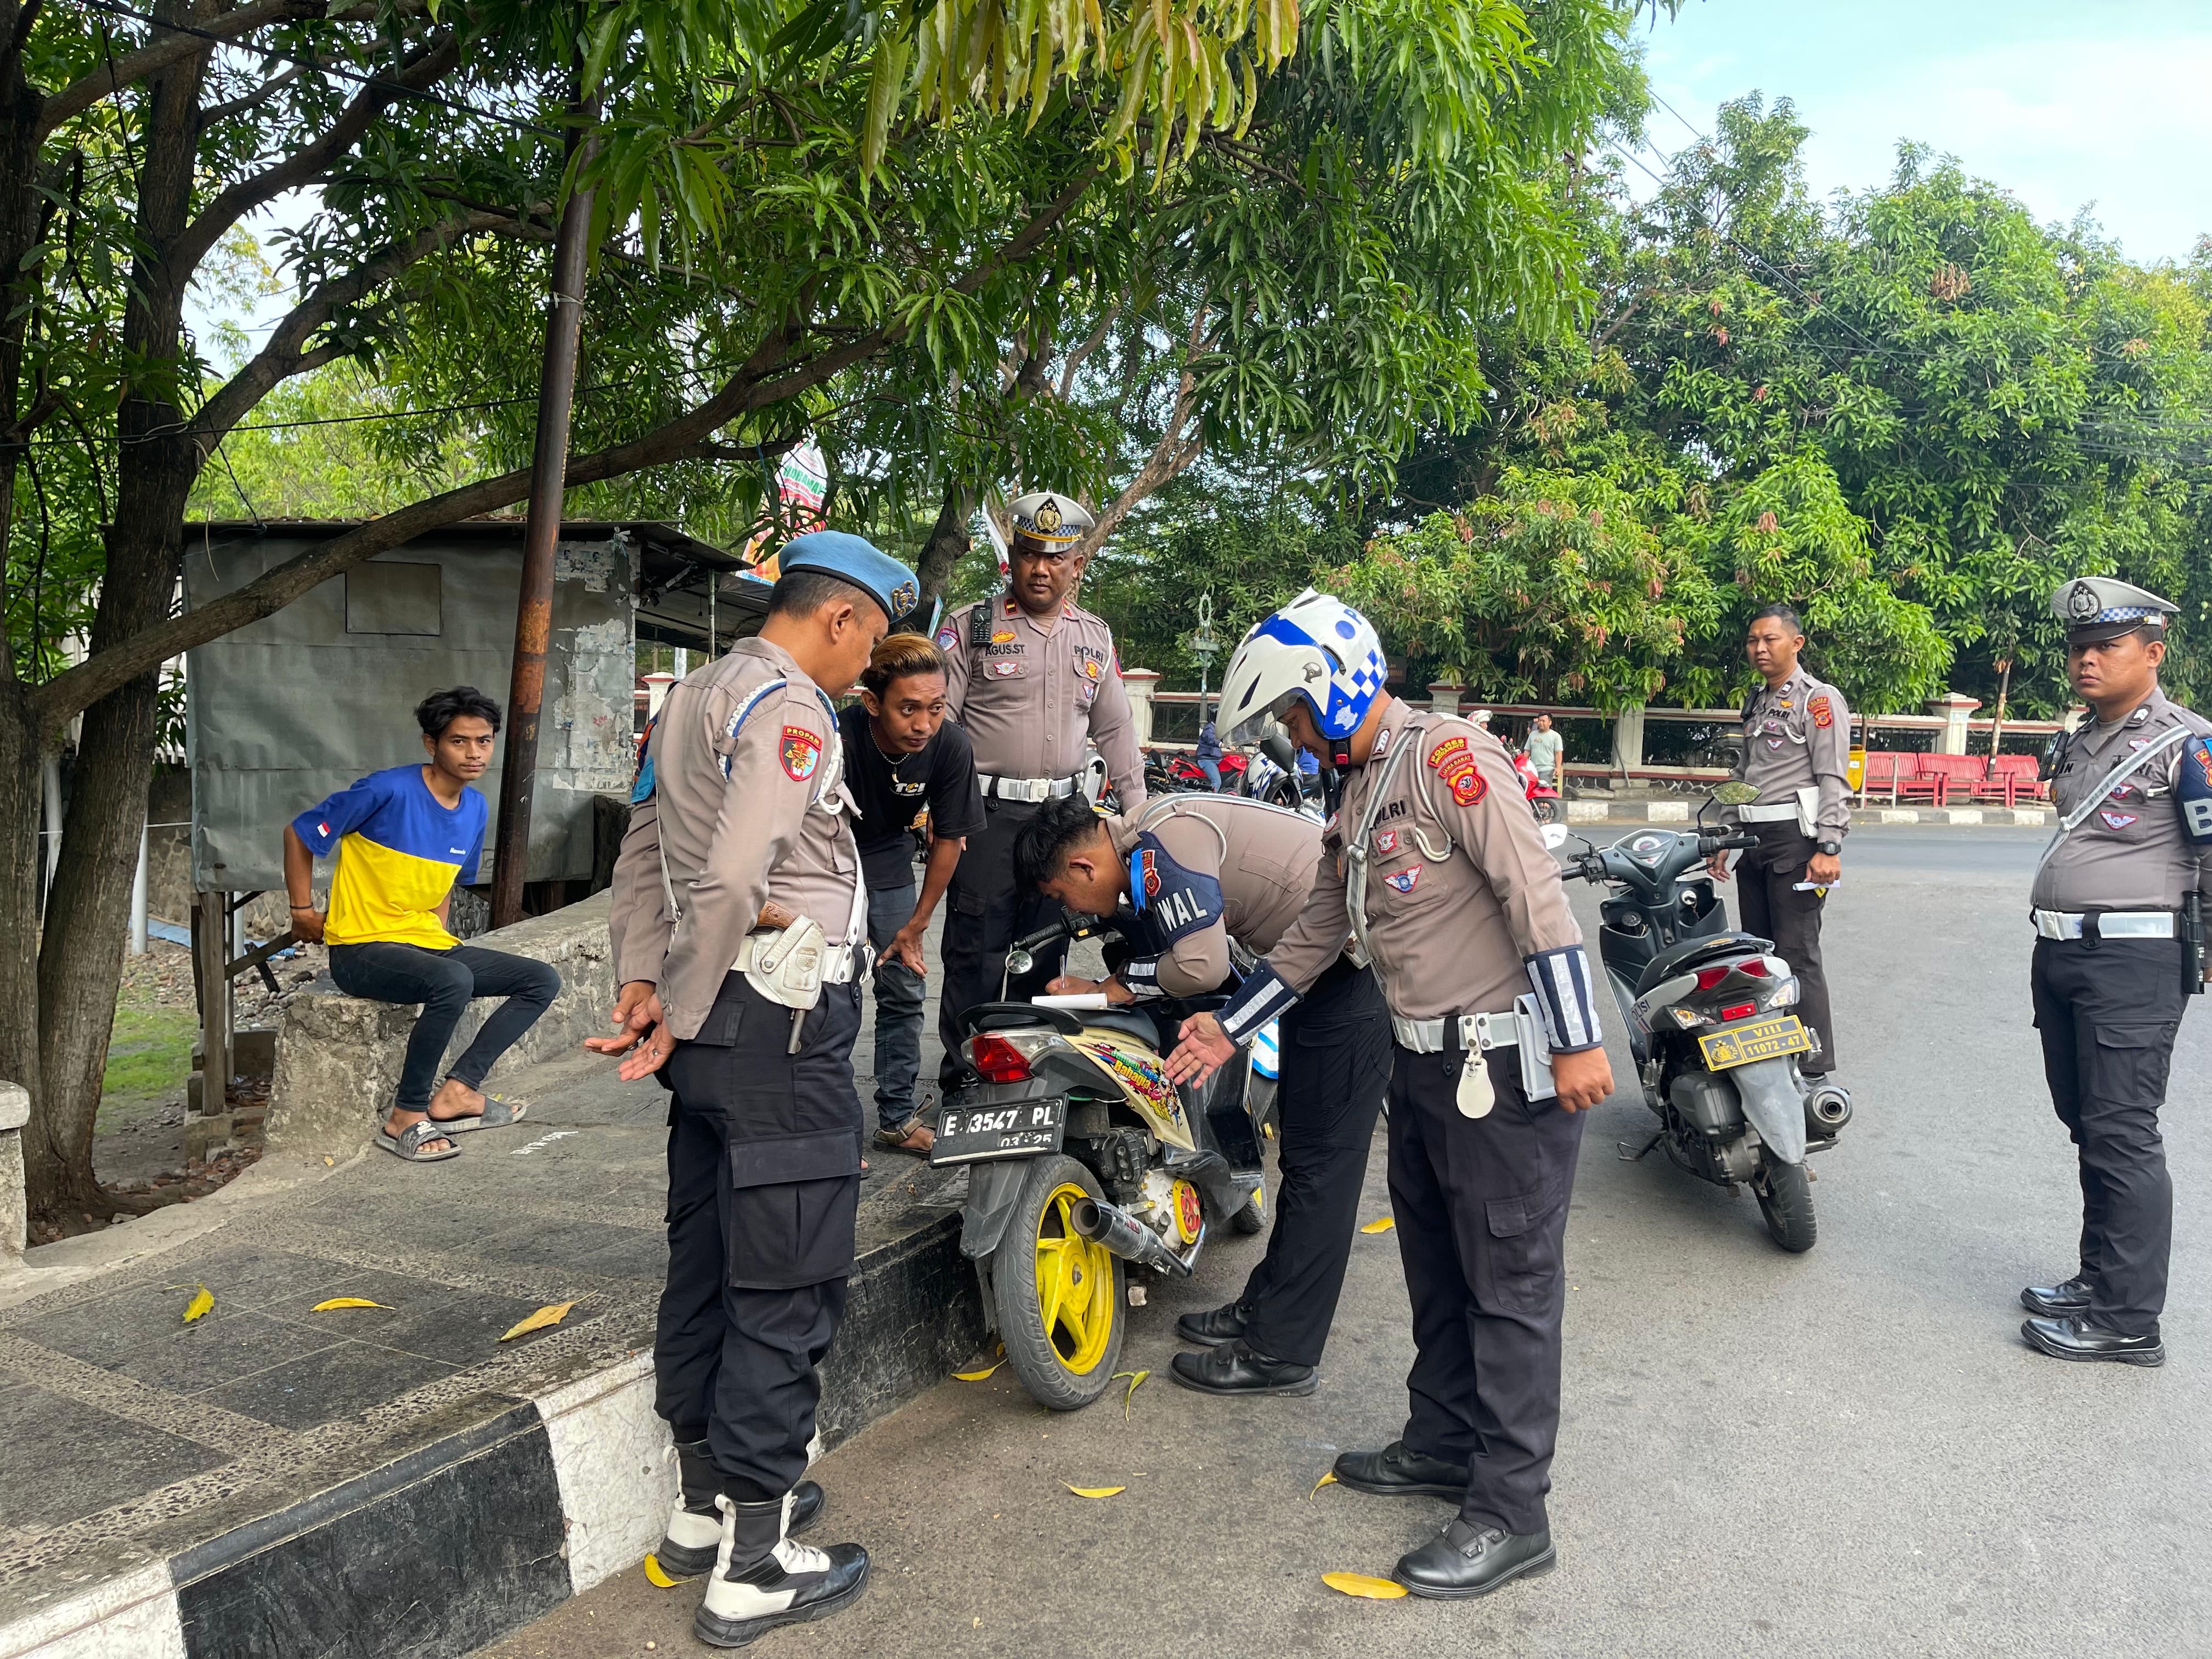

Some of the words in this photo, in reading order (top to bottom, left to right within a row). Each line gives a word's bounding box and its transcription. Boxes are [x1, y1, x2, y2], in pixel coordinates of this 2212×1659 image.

[985, 644, 1024, 656] AGUS.ST
[1074, 645, 1103, 663] POLRI
[1768, 708, 1790, 719] POLRI
[786, 727, 820, 745] PROPAM
[1431, 738, 1465, 762] POLRES
[1442, 763, 1455, 776] JAWA
[1454, 755, 1471, 767] BARAT
[1155, 887, 1207, 936] WAL
[1632, 999, 1651, 1021] OLISI
[1753, 1024, 1782, 1037] VIII
[1110, 1048, 1141, 1070] Jangan
[1141, 1064, 1159, 1083] Lupa
[1113, 1059, 1151, 1090] Bahagia
[944, 1115, 957, 1137] E
[969, 1110, 1018, 1133] 3547
[1031, 1106, 1053, 1126] PL
